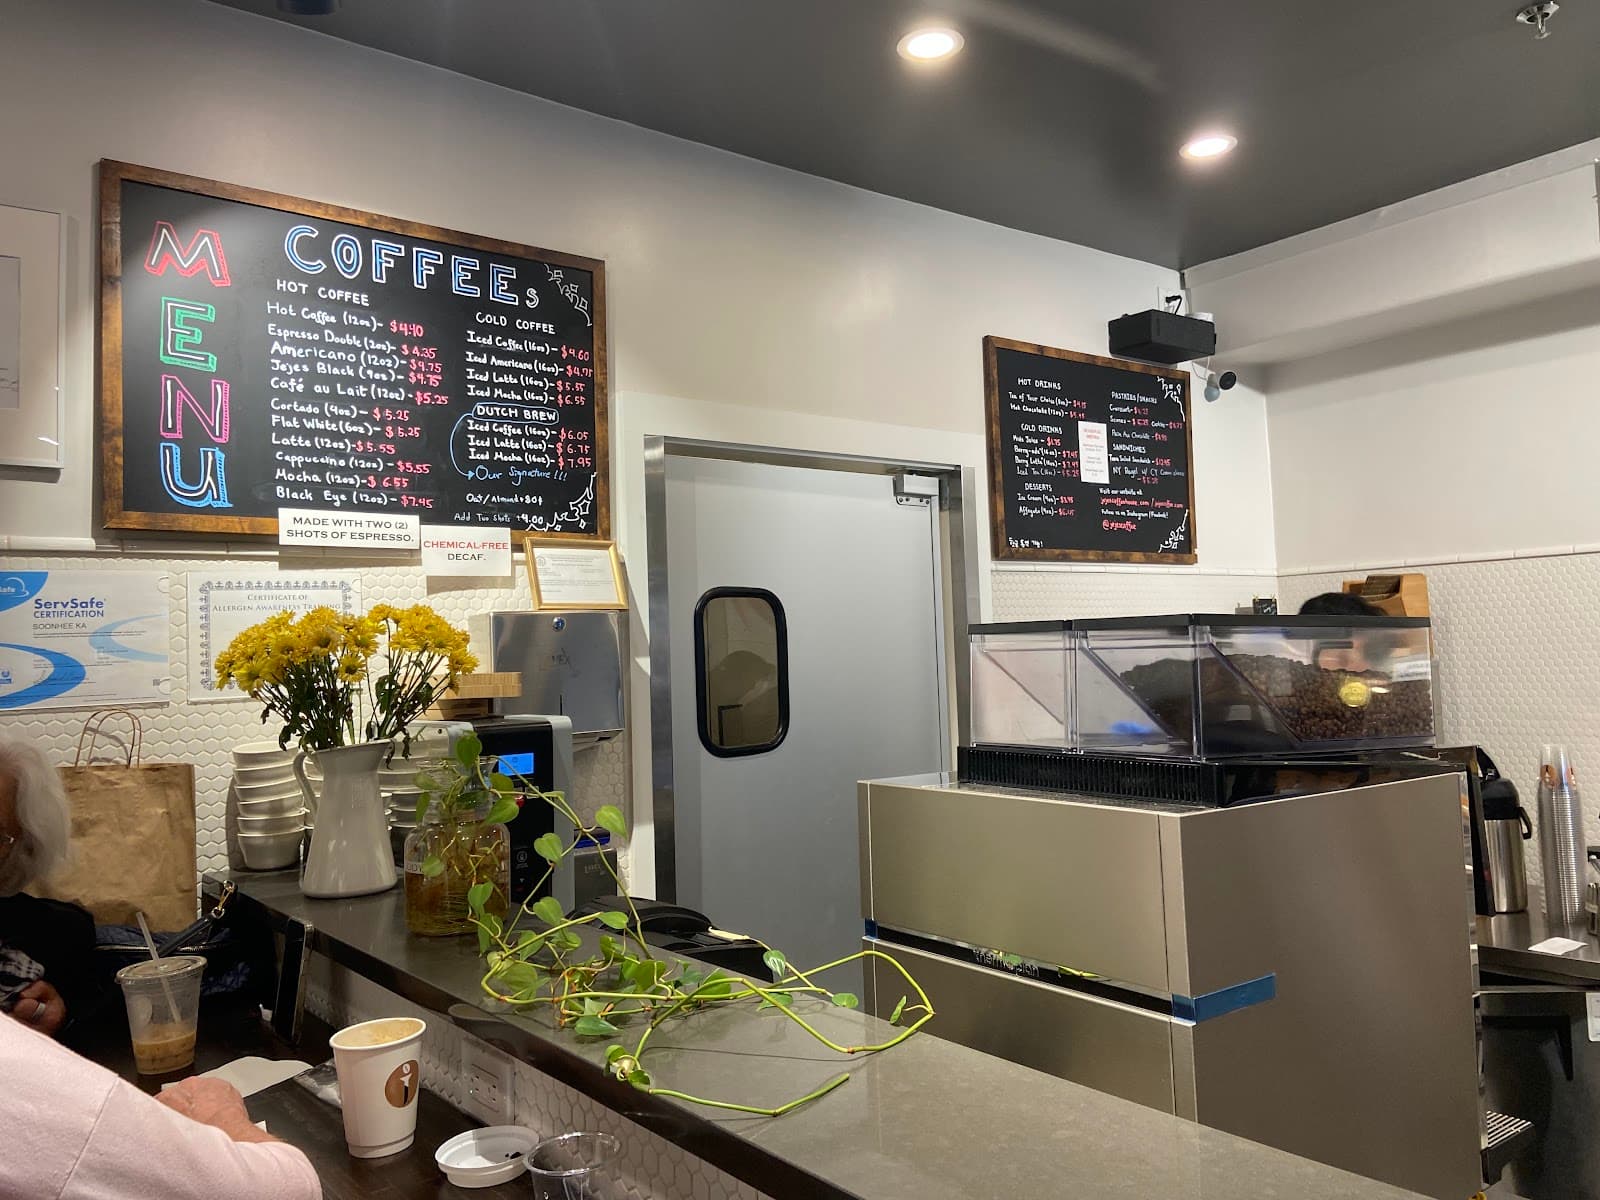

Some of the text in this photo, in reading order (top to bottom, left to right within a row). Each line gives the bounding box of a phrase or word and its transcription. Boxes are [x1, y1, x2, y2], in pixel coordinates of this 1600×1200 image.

[276, 278, 370, 306] HOT COFFEE
[266, 301, 296, 316] Hot
[301, 308, 337, 326] Coffee
[475, 312, 556, 335] COLD COFFEE
[268, 324, 320, 342] Espresso
[324, 330, 362, 347] Double
[466, 330, 493, 346] Iced
[495, 336, 524, 351] Coffee
[270, 340, 356, 362] Americano
[466, 351, 488, 364] Iced
[490, 355, 532, 370] Americano
[316, 362, 354, 378] Black
[466, 368, 488, 382] Iced
[492, 372, 518, 384] Latte
[270, 376, 305, 393] Café
[314, 384, 330, 394] au
[336, 384, 369, 398] Lait
[1018, 377, 1062, 390] HOT DRINKS
[466, 384, 490, 398] Iced
[494, 388, 522, 401] Mocha
[270, 398, 320, 414] Cortado
[476, 406, 556, 421] DUTCH BREW
[271, 414, 300, 428] Flat
[302, 418, 338, 432] White
[466, 420, 490, 432] Iced
[492, 423, 522, 436] Coffee
[1020, 423, 1036, 432] COLD
[271, 432, 312, 448] Latte
[466, 434, 490, 447] Iced
[494, 437, 521, 449] Latte
[468, 448, 490, 460] Iced
[494, 452, 523, 462] Mocha
[274, 468, 322, 484] Mocha
[475, 465, 502, 480] Our
[1024, 482, 1052, 492] DESSERTS
[276, 486, 314, 501] Black
[324, 490, 348, 507] Eye
[292, 516, 408, 530] MADE WITH TWO (2)
[454, 512, 471, 522] Add
[476, 513, 490, 522] Two
[286, 529, 414, 542] SHOTS OF ESPRESSO.
[423, 540, 509, 550] CHEMICAL-FREE
[447, 553, 487, 561] DECAF.
[34, 597, 104, 610] ServSafe
[34, 610, 104, 618] CERTIFICATION
[32, 622, 87, 630] SOONHEE KA
